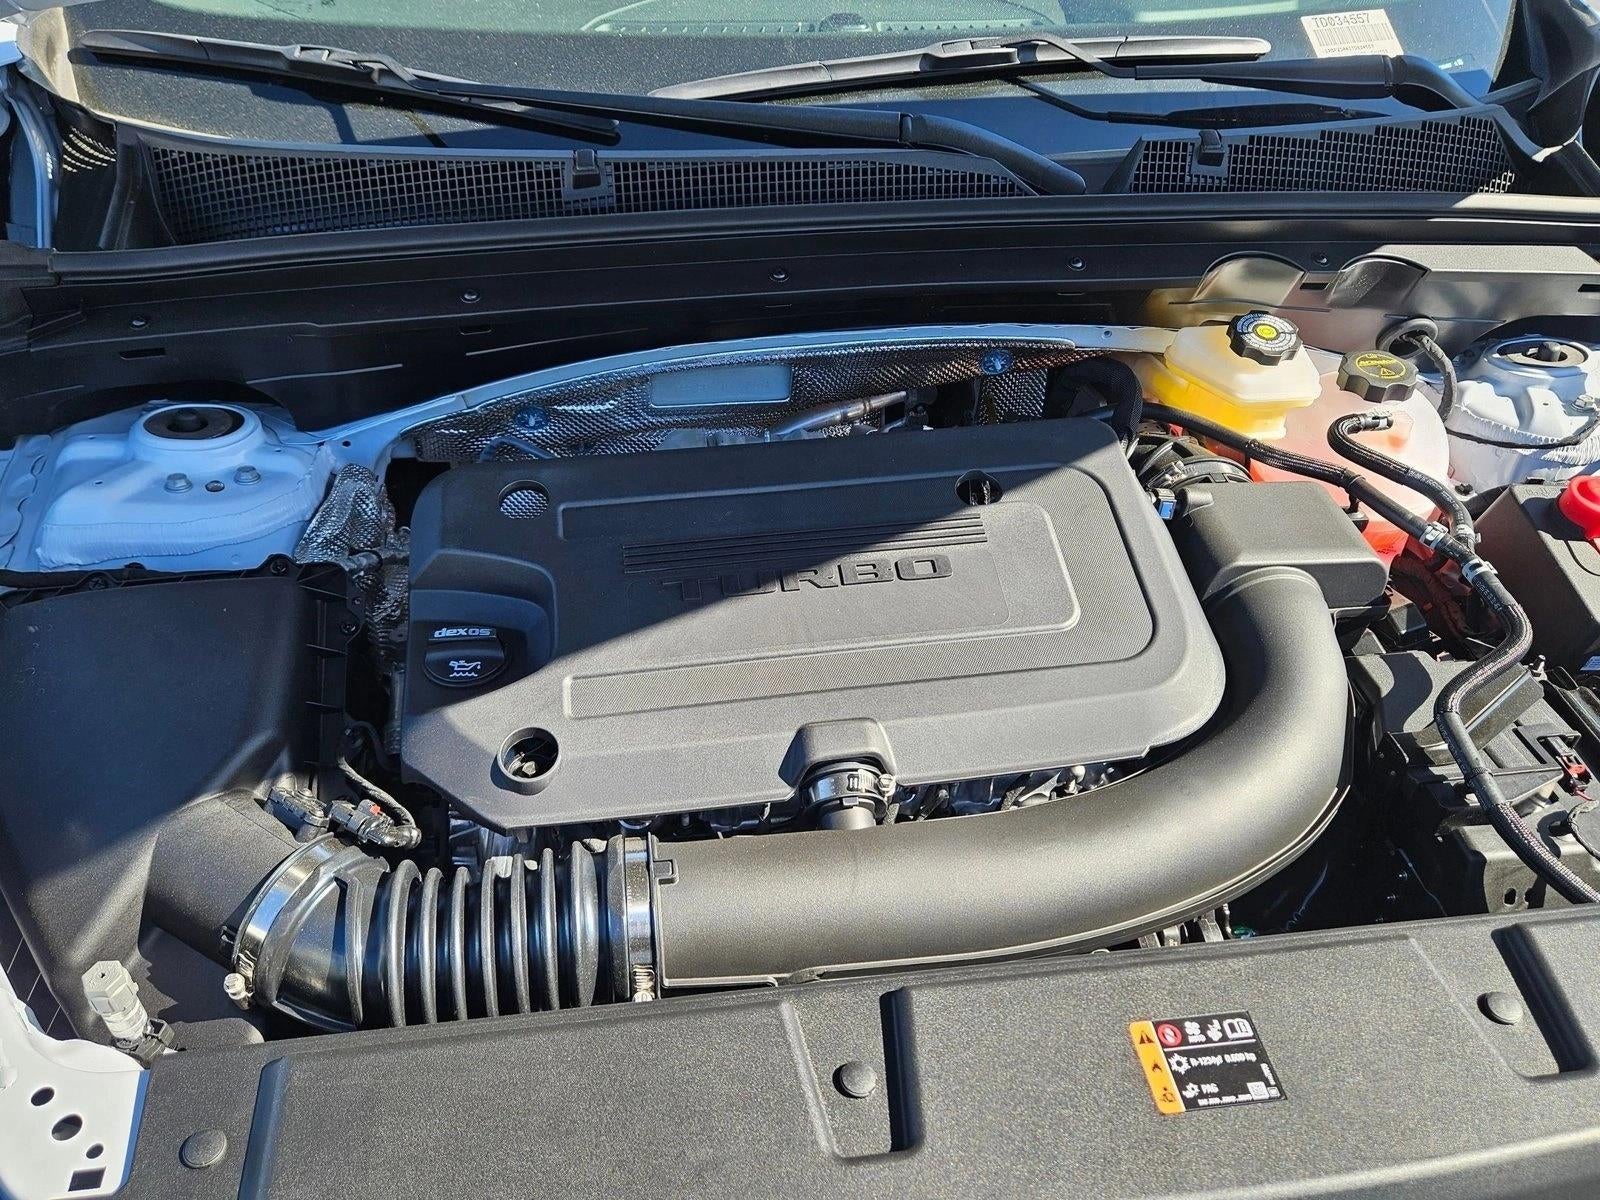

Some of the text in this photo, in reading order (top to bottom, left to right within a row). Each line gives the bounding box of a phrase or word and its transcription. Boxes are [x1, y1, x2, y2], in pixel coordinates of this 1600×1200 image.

[1311, 13, 1370, 28] TD034557
[662, 555, 953, 601] TURBO
[434, 627, 491, 638] dexos
